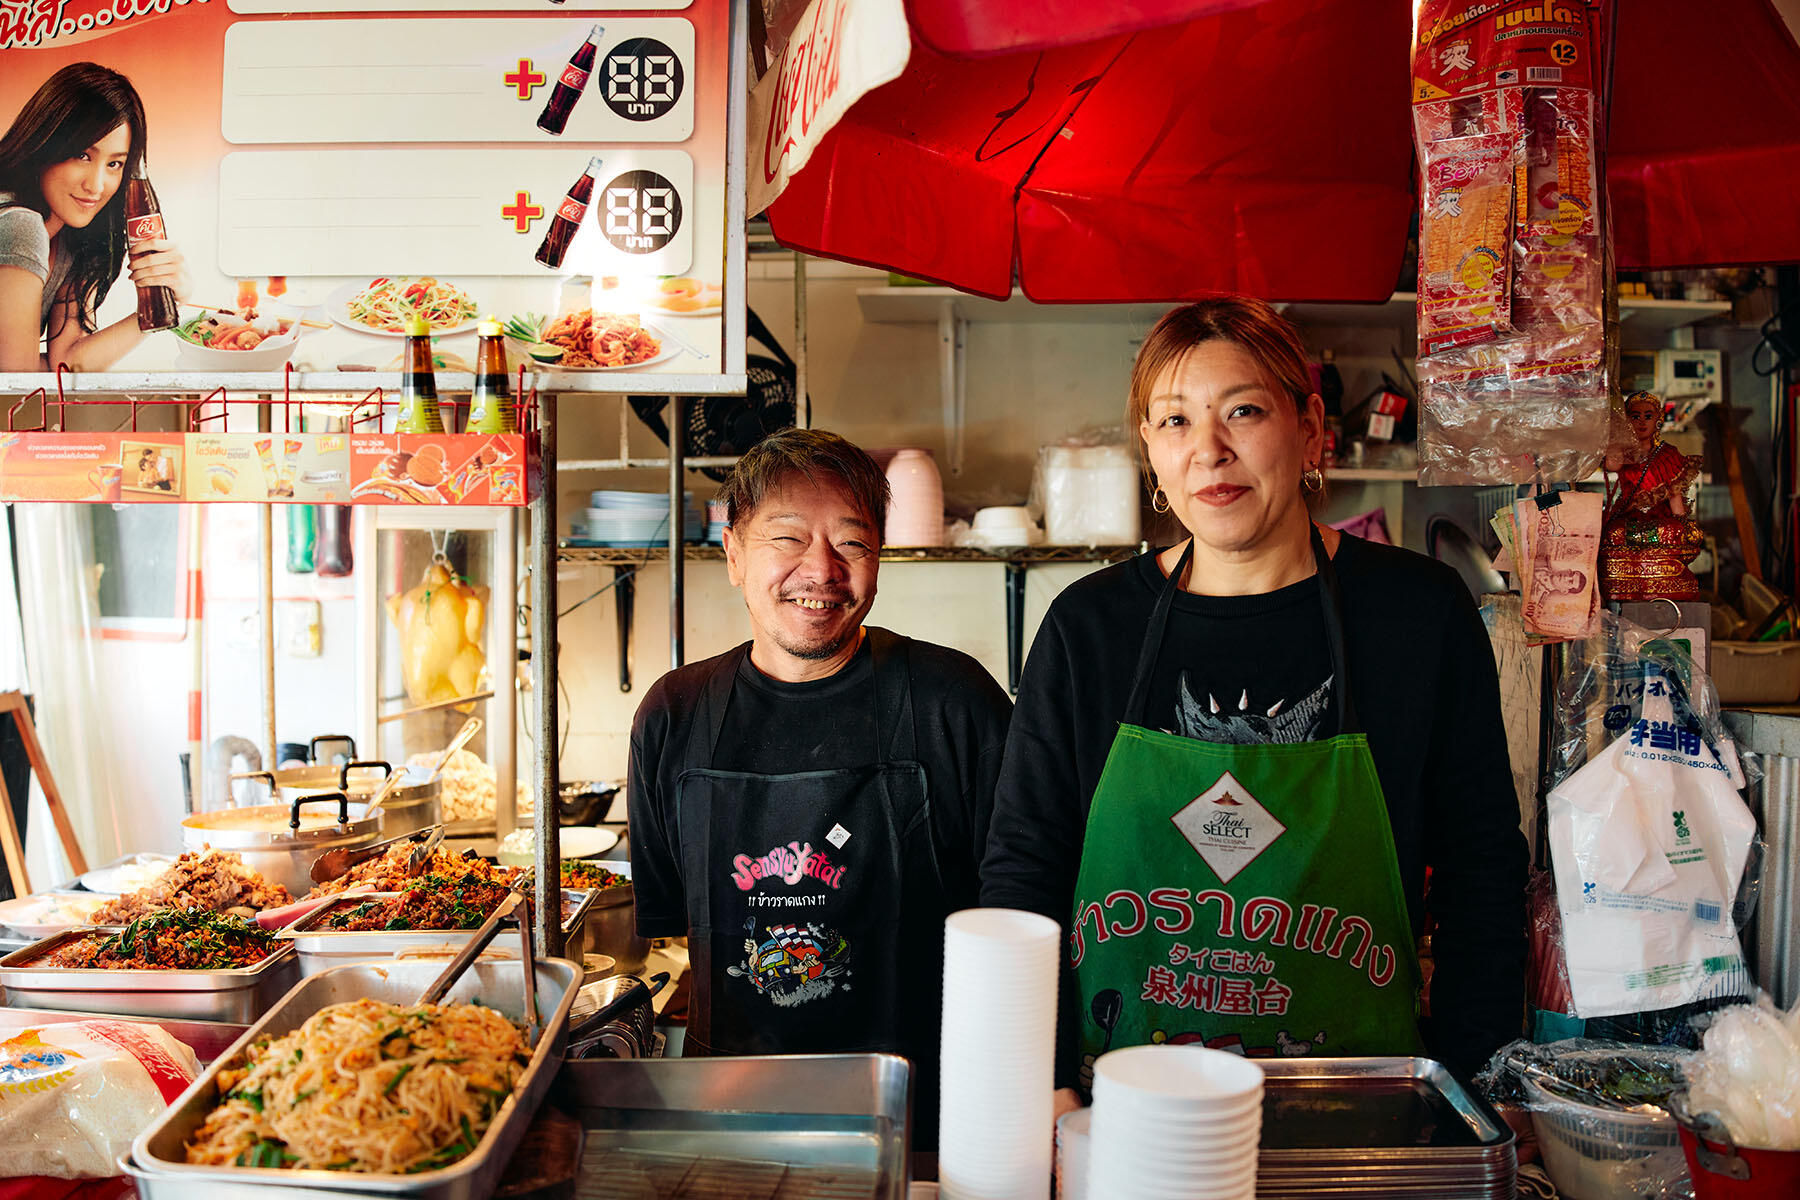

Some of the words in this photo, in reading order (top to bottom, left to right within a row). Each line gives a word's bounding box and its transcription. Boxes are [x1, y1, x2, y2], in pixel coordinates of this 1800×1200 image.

[1496, 0, 1582, 30] เบนโตะ
[1553, 44, 1576, 60] 12
[627, 103, 655, 115] บาท
[625, 235, 653, 248] บาท
[1212, 811, 1244, 827] Thai
[1203, 824, 1252, 838] SELECT
[1169, 943, 1275, 974] タイごはん
[1141, 966, 1292, 1016] 泉州屋台
